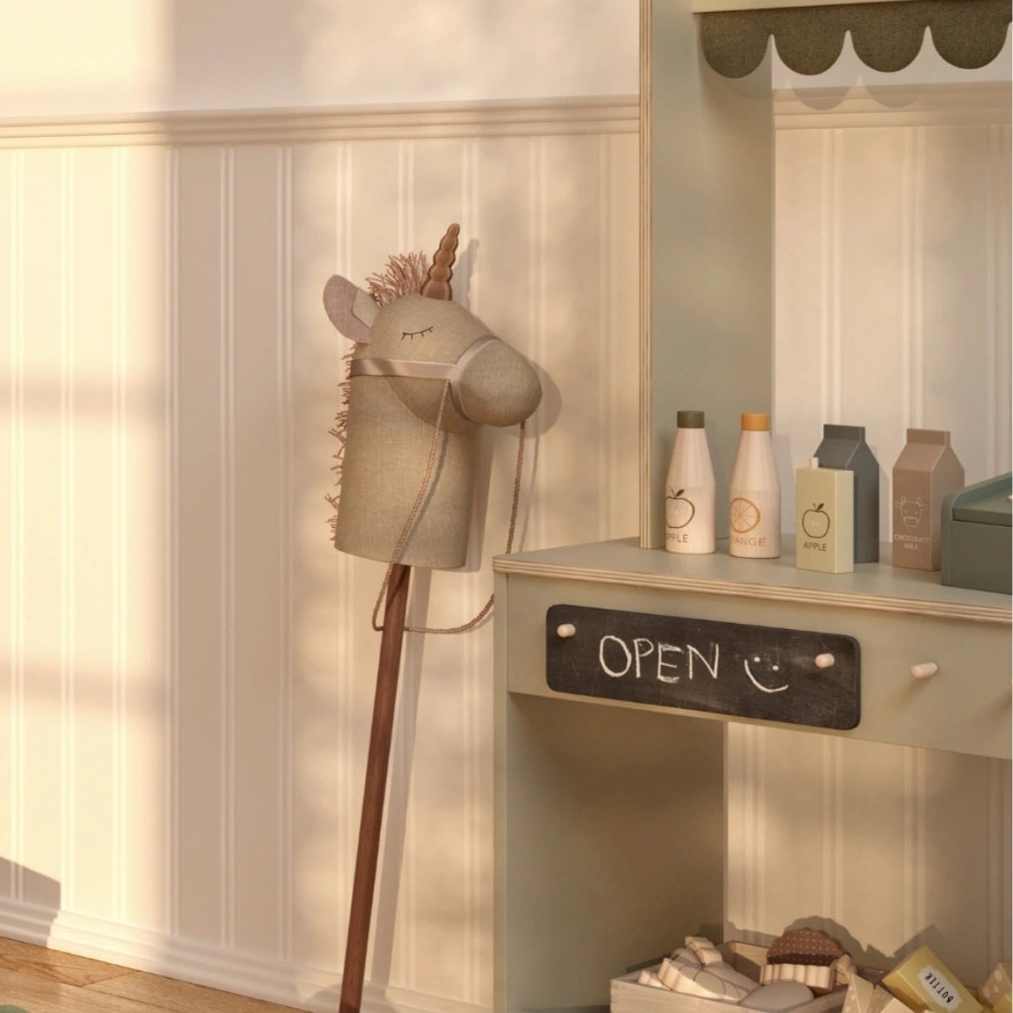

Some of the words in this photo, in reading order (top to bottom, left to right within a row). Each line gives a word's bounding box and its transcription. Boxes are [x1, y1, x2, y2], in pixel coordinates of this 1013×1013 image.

[666, 533, 689, 544] PPLE
[803, 541, 828, 552] APPLE
[598, 634, 720, 684] OPEN
[924, 971, 955, 1004] BUTTER
